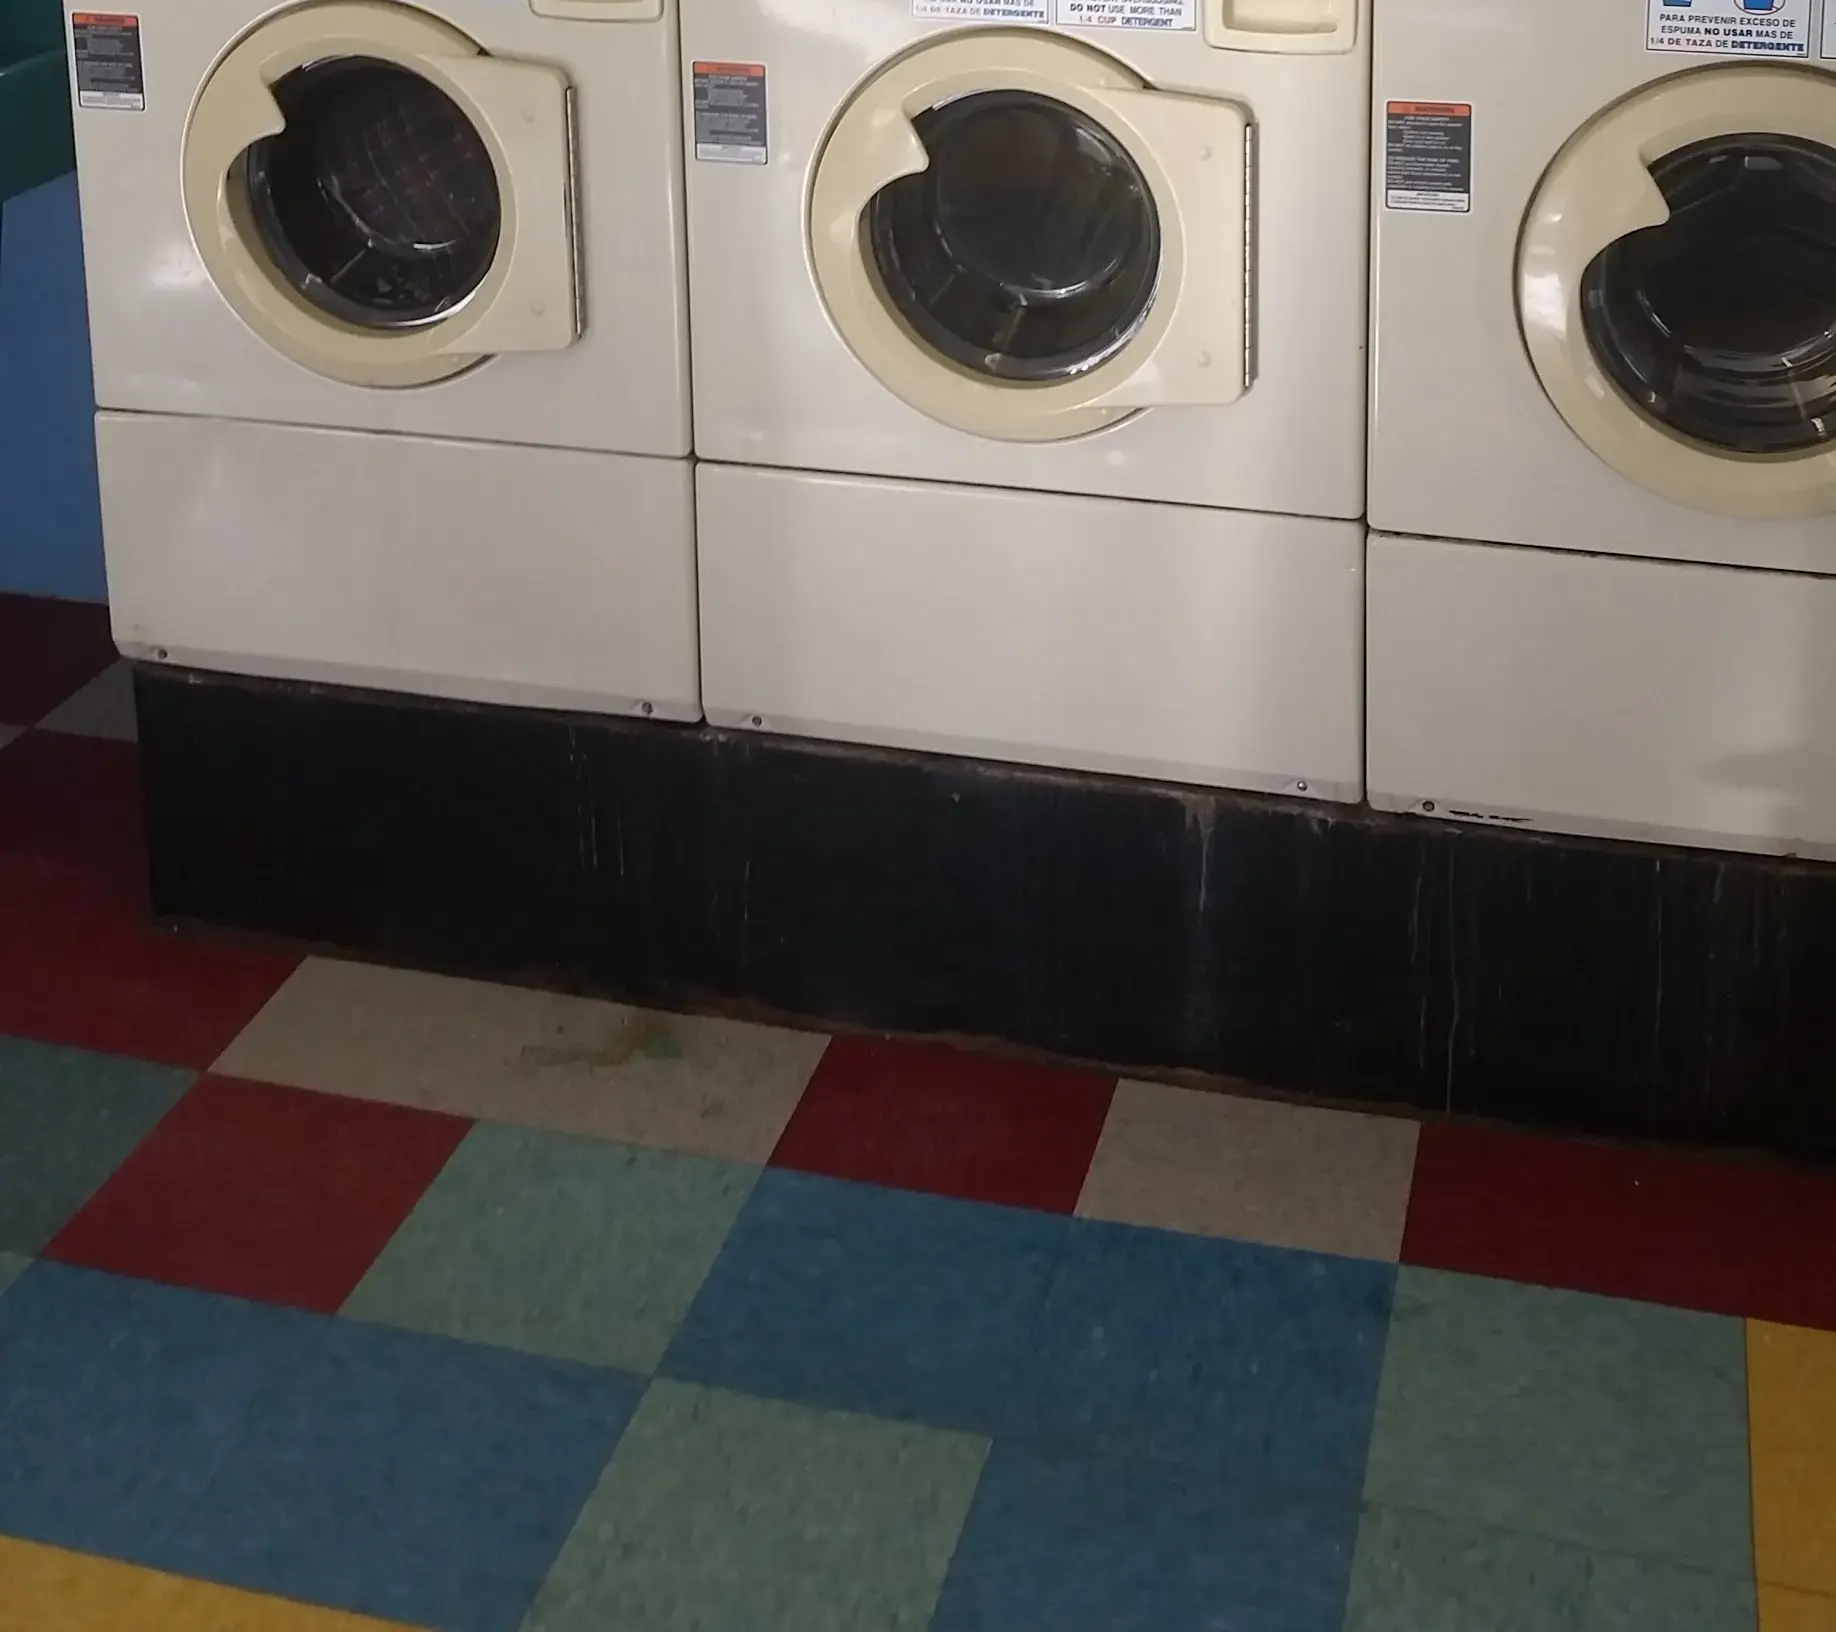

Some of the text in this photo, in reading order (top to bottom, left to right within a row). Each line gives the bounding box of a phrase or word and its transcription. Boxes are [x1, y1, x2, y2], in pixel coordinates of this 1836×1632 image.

[1023, 0, 1035, 7] DE
[1070, 3, 1182, 16] DO NOT USE MORE THAN
[983, 8, 1044, 18] DETERGENTE
[1098, 16, 1116, 24] CUP
[1122, 16, 1174, 27] DETERGENT
[1660, 13, 1796, 28] PARA PREVENIR EXCESO DE
[1661, 25, 1793, 39] ESPUMA NO USAR MAS DE
[1667, 38, 1682, 46] DE
[1686, 38, 1713, 47] TAZA
[1715, 40, 1729, 48] DE
[1731, 41, 1804, 52] DETERGENTE
